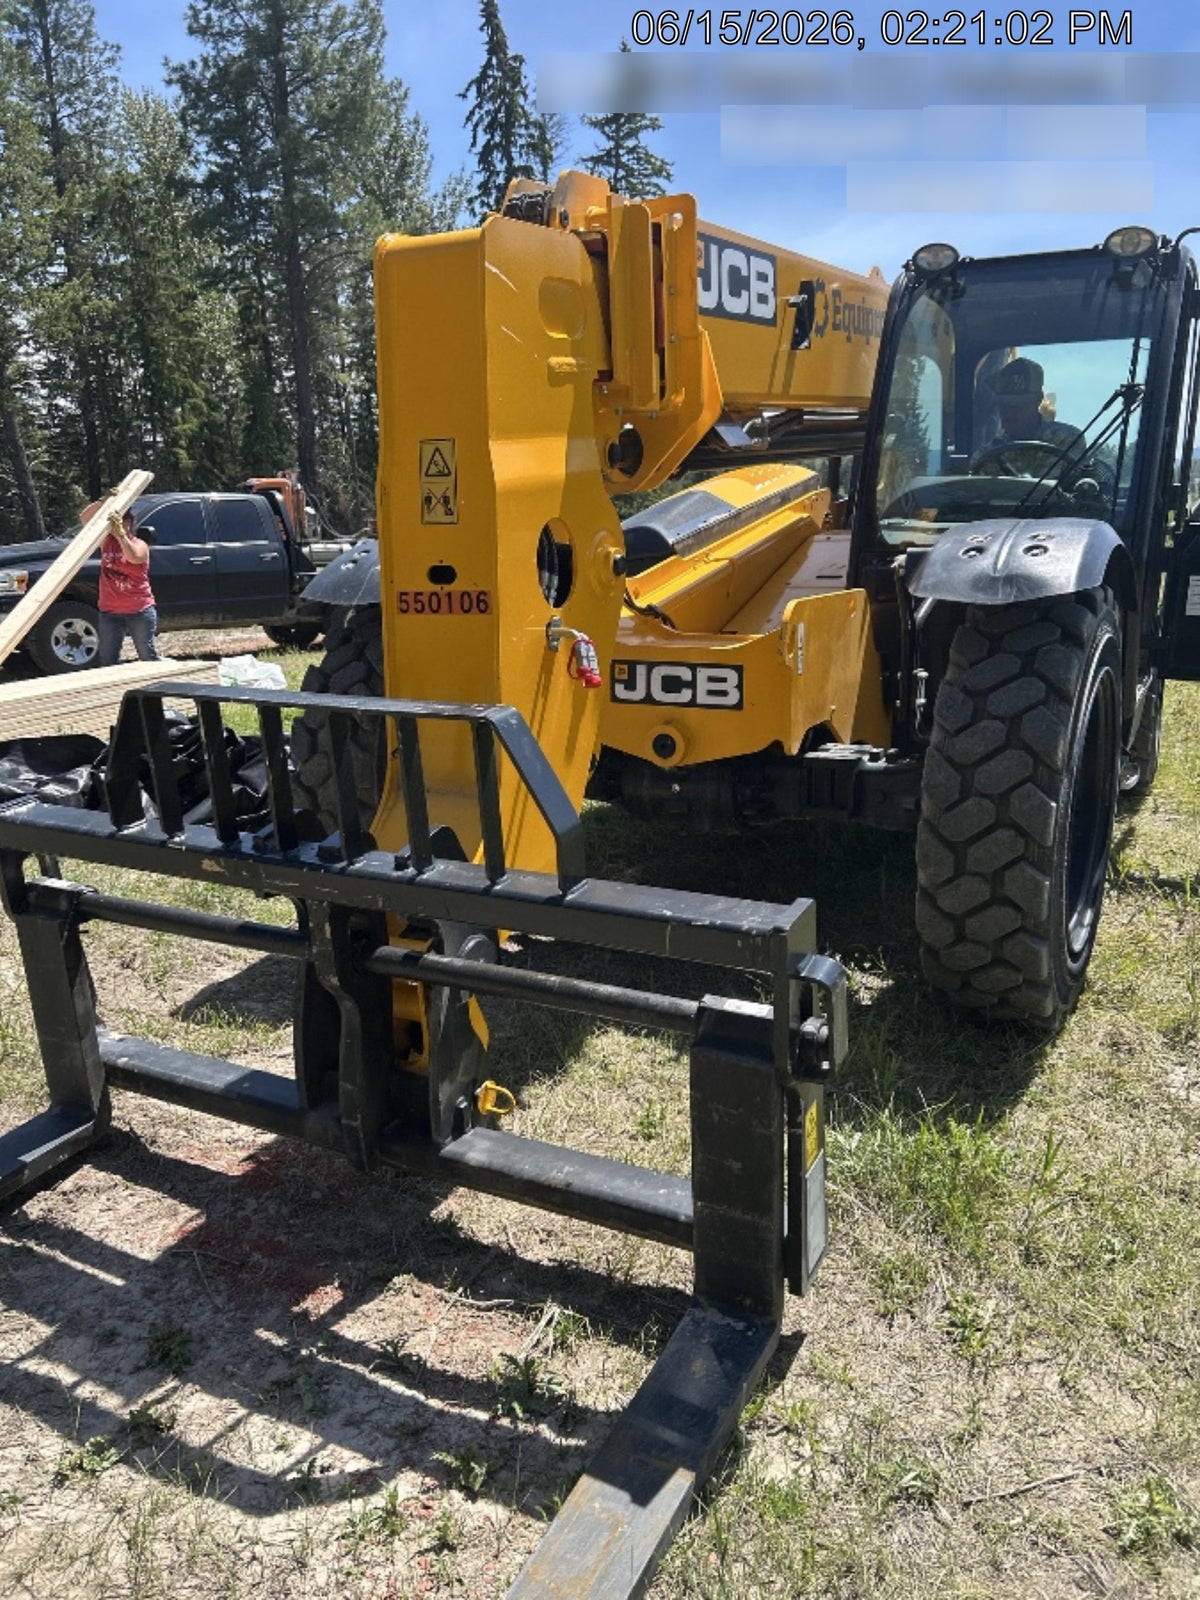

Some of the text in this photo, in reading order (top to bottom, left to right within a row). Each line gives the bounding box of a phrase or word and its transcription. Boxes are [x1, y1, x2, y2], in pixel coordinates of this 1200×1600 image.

[697, 242, 775, 320] JCB
[398, 591, 489, 614] 550106
[614, 664, 741, 706] JCB
